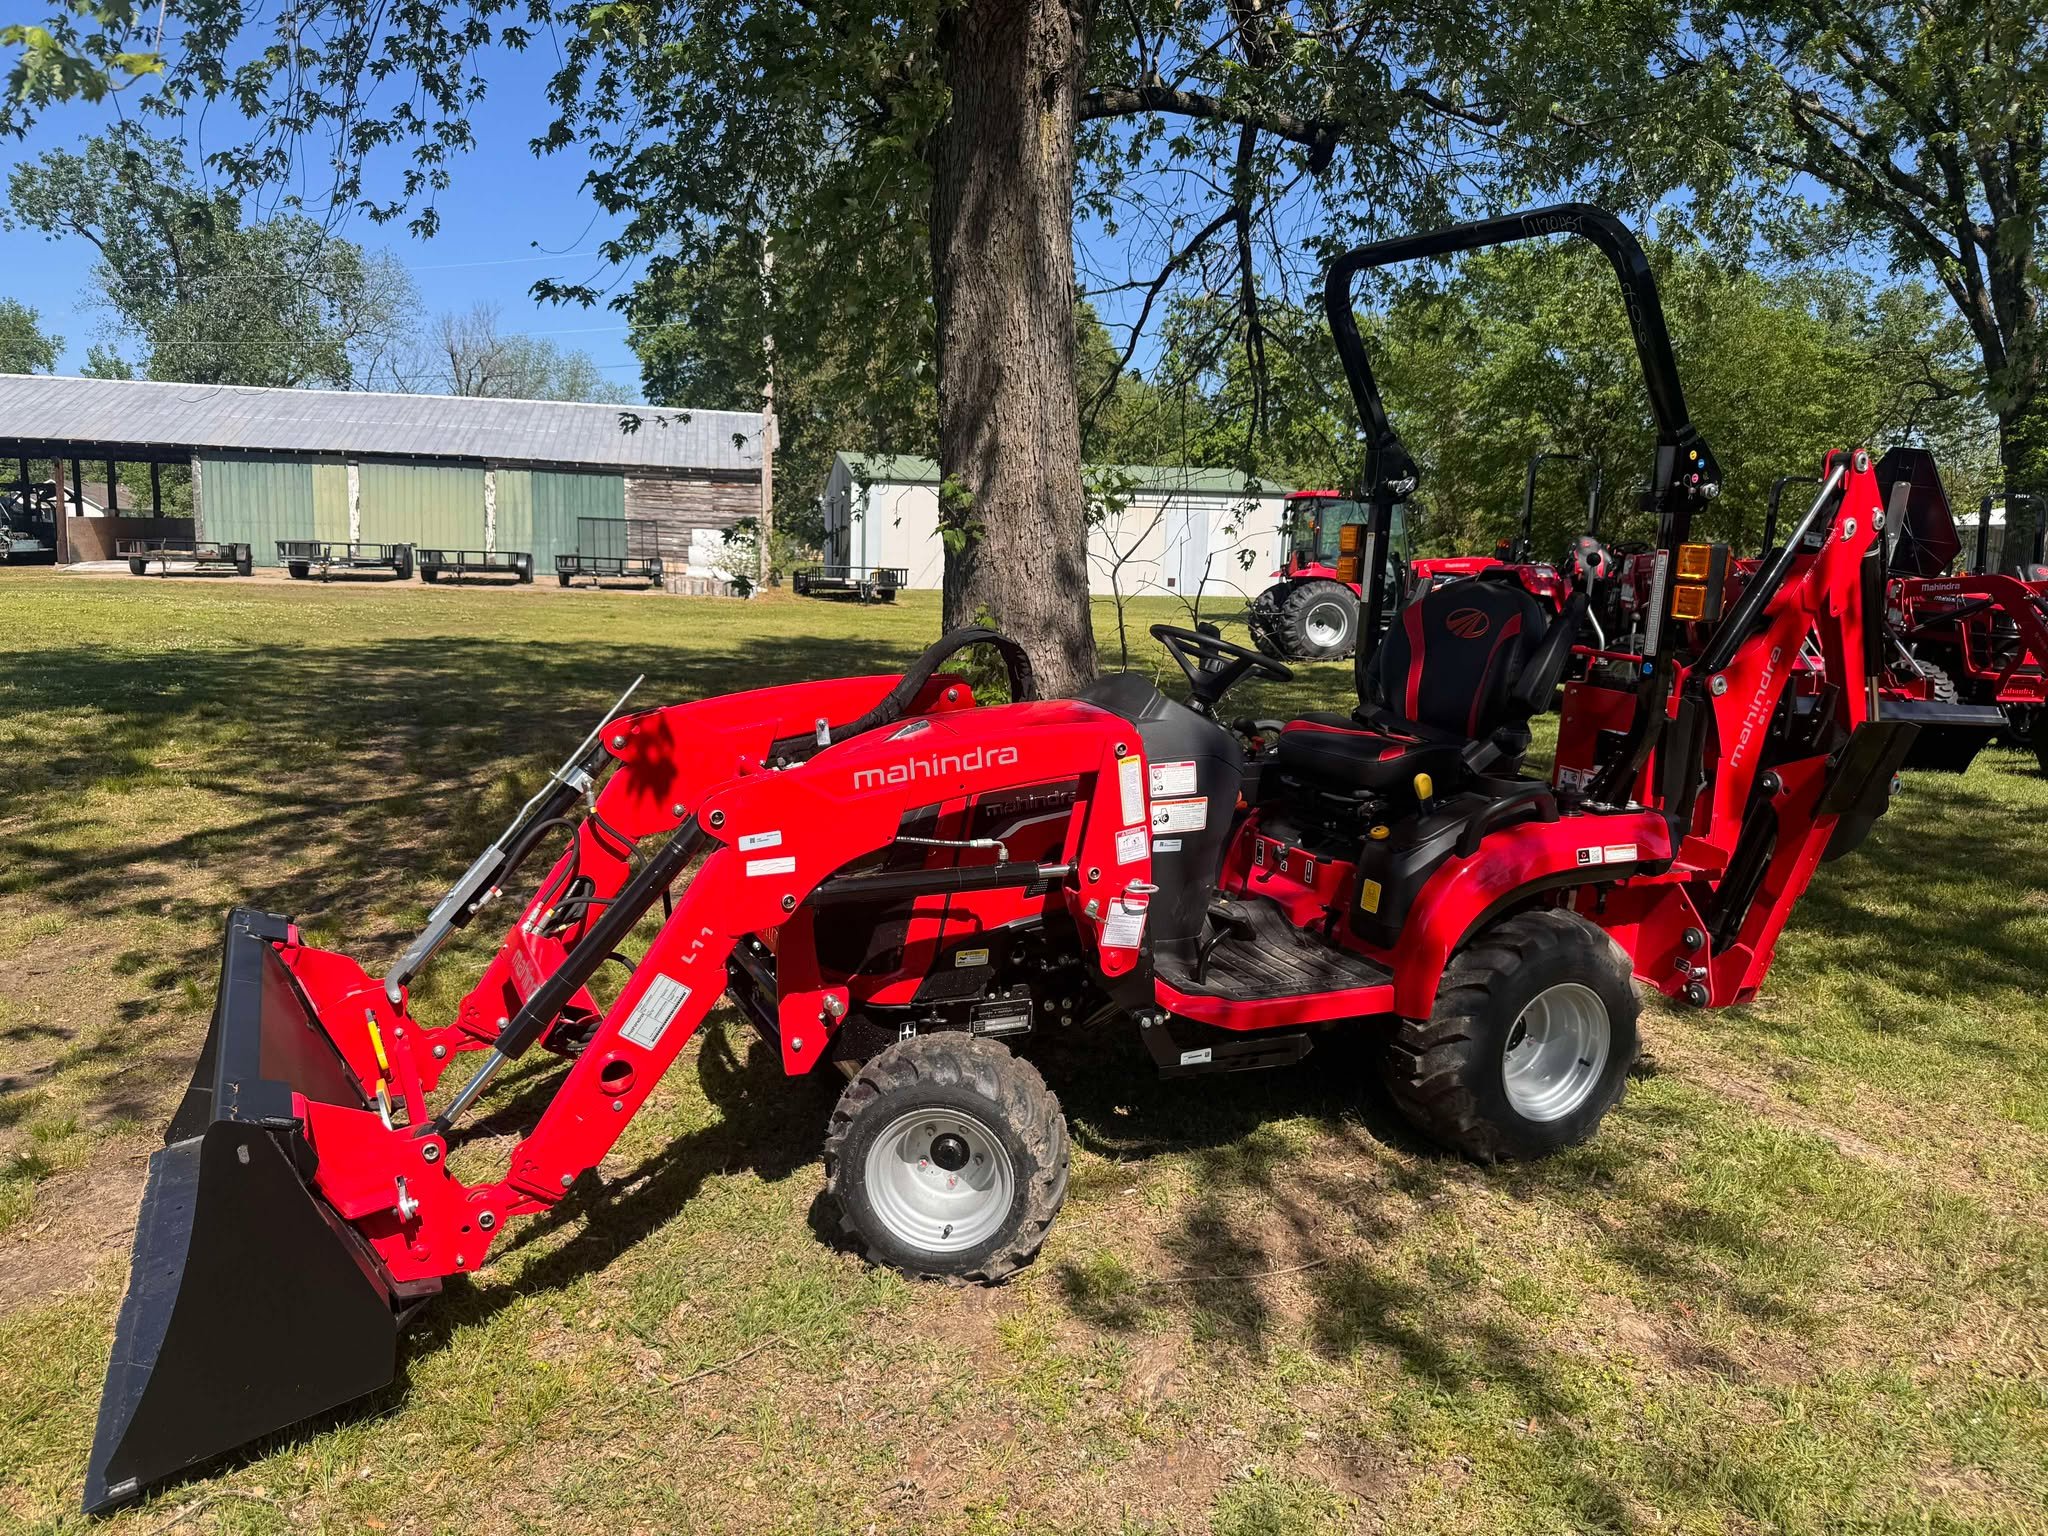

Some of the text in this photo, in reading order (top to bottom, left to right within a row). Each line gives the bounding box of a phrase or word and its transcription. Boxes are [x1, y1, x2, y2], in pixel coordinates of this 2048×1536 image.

[1730, 645, 1782, 768] mahindra
[853, 746, 1018, 790] mahindra
[681, 926, 713, 965] L11
